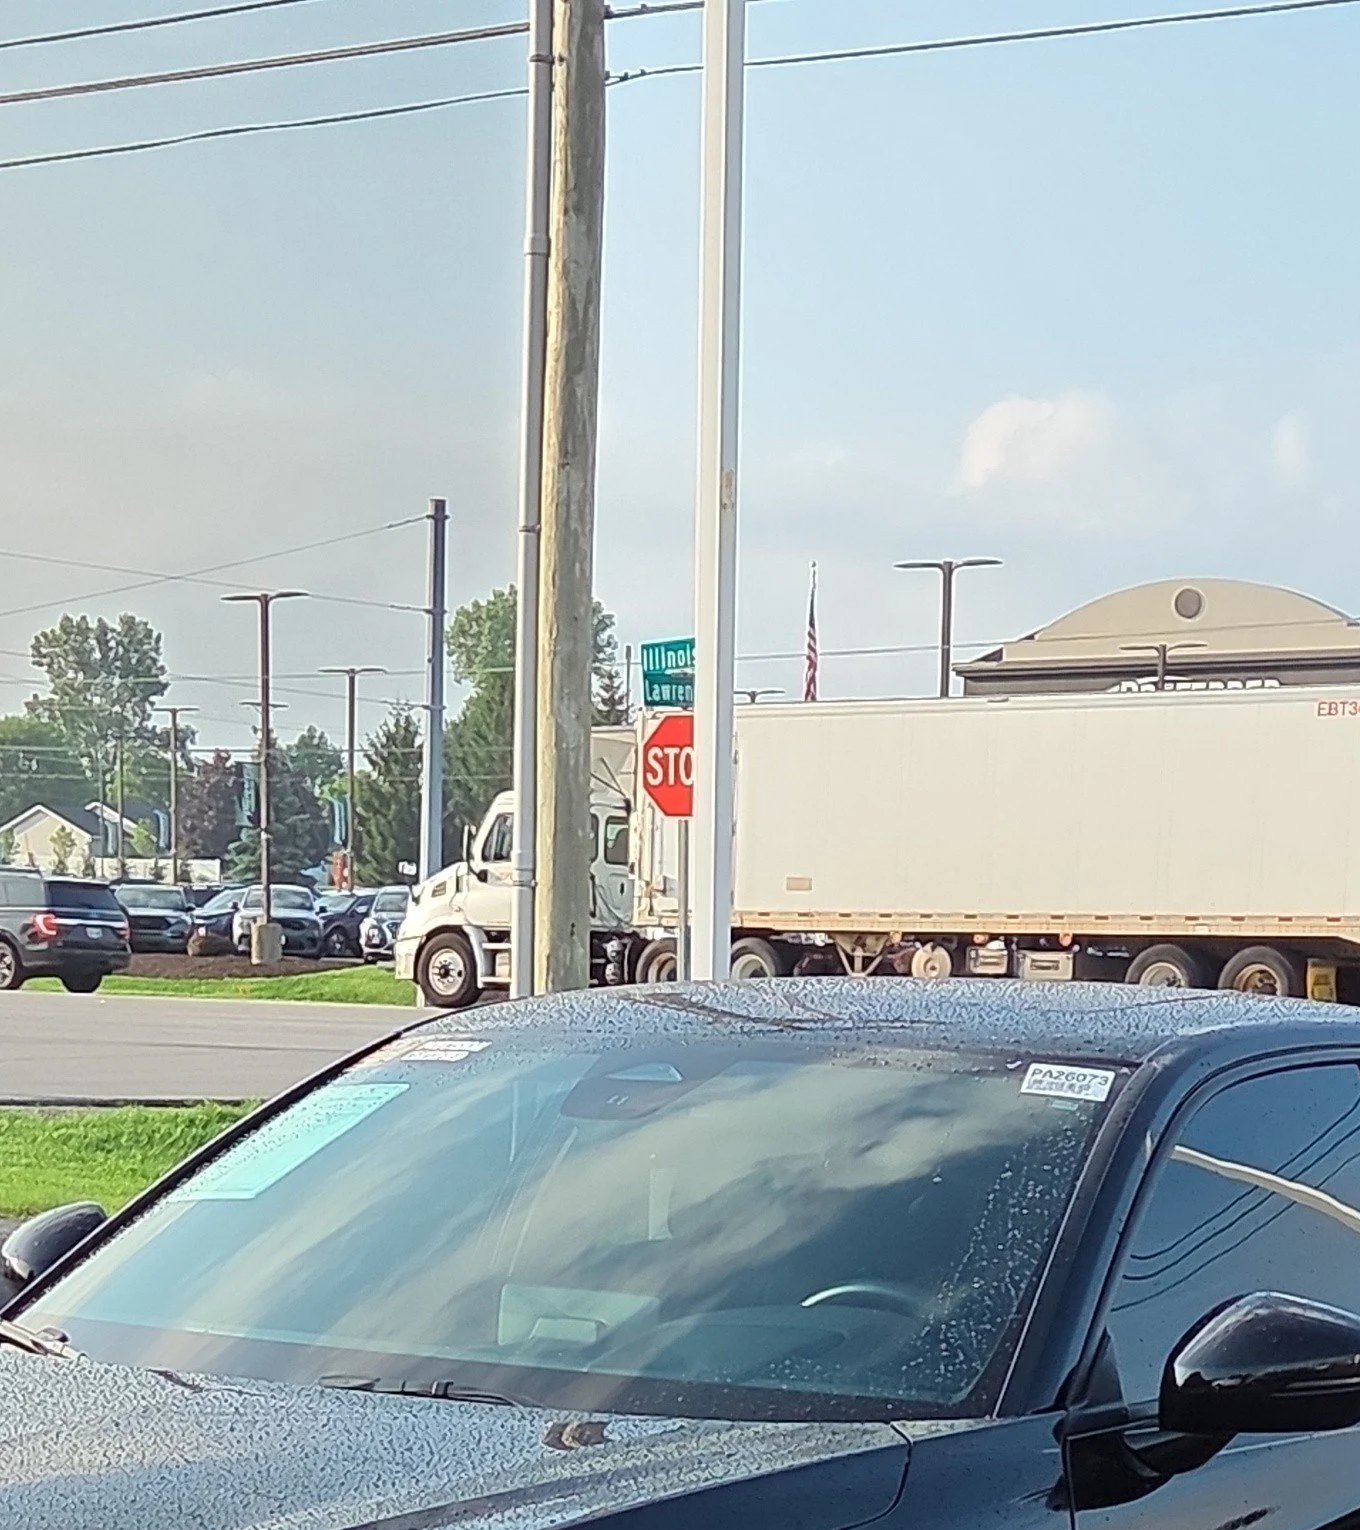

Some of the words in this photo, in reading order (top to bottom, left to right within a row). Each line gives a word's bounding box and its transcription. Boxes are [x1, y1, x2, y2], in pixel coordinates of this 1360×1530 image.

[645, 679, 693, 702] Lawren
[646, 746, 694, 787] STO
[1031, 1067, 1110, 1086] PA26073
